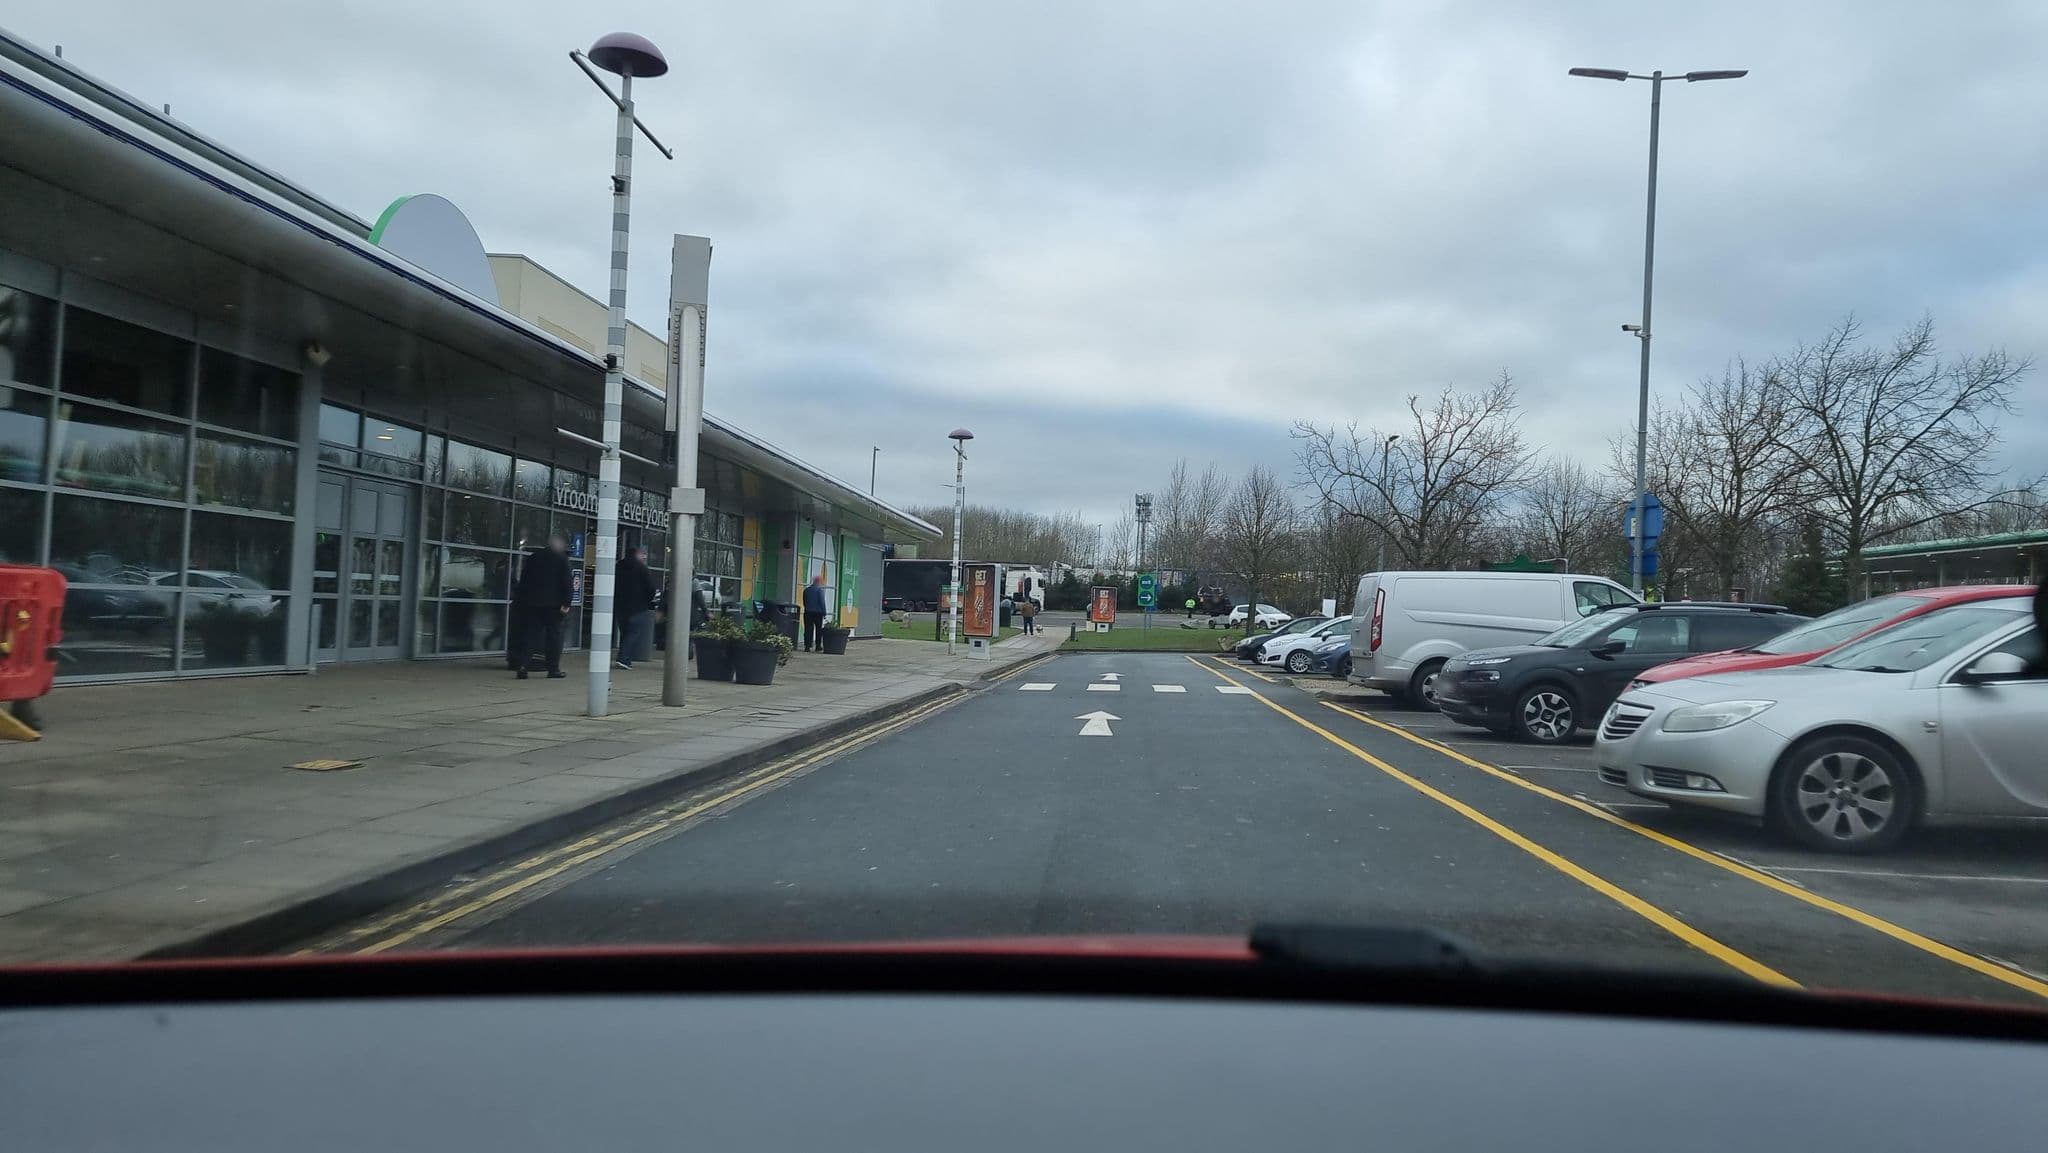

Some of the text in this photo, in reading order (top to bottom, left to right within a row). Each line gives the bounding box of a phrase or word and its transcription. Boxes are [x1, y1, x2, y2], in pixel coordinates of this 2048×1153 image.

[556, 486, 670, 528] vroom everyone
[975, 570, 987, 580] GET
